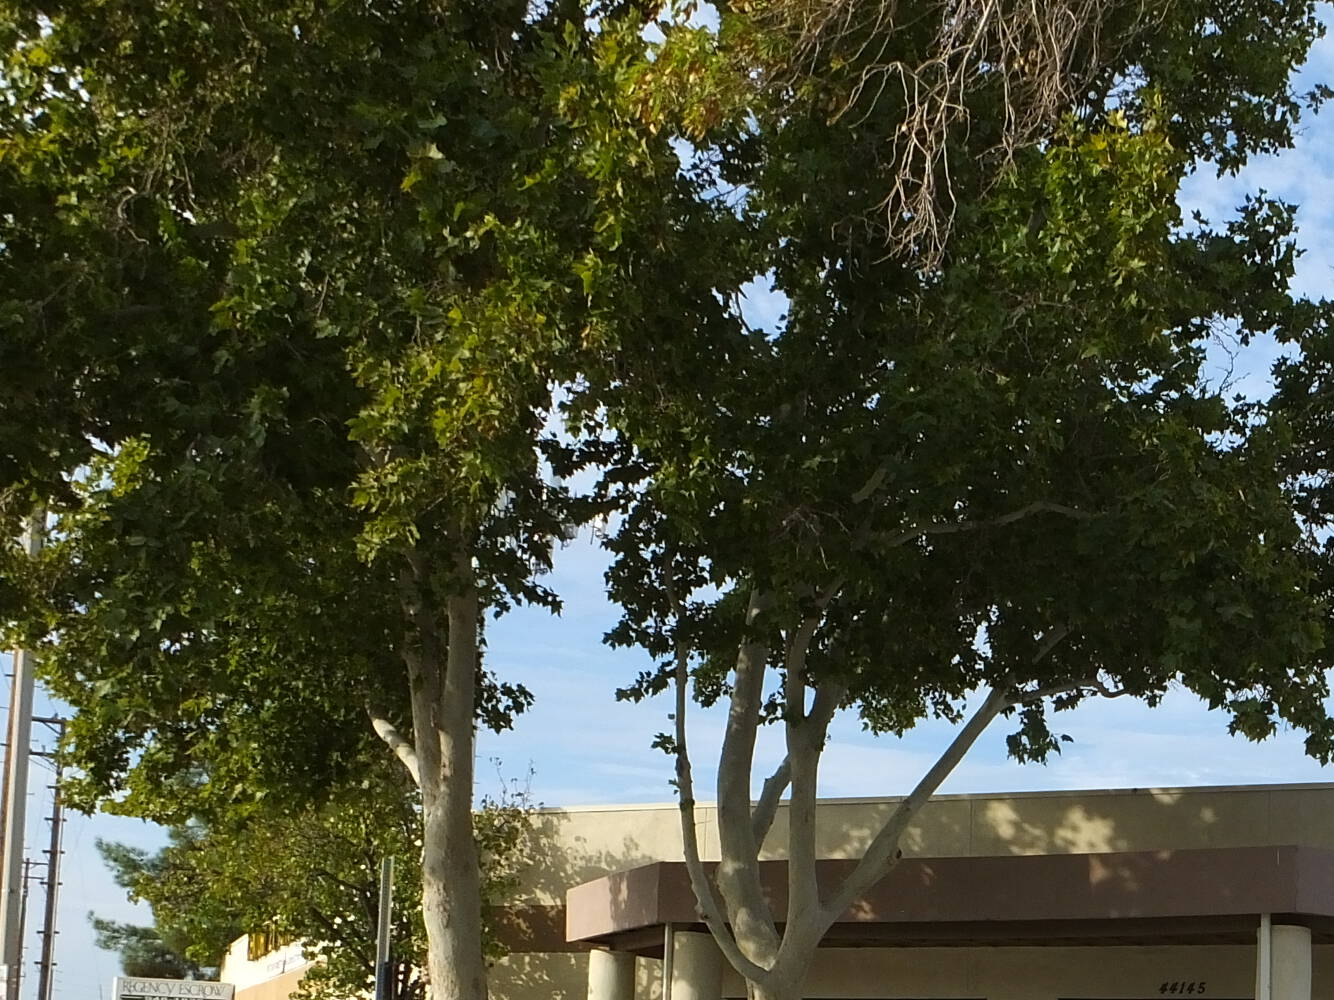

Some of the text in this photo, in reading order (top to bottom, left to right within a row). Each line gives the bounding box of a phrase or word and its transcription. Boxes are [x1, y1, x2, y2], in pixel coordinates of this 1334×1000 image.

[122, 981, 226, 997] REGENCY ESCROW
[1159, 981, 1206, 994] 44145
